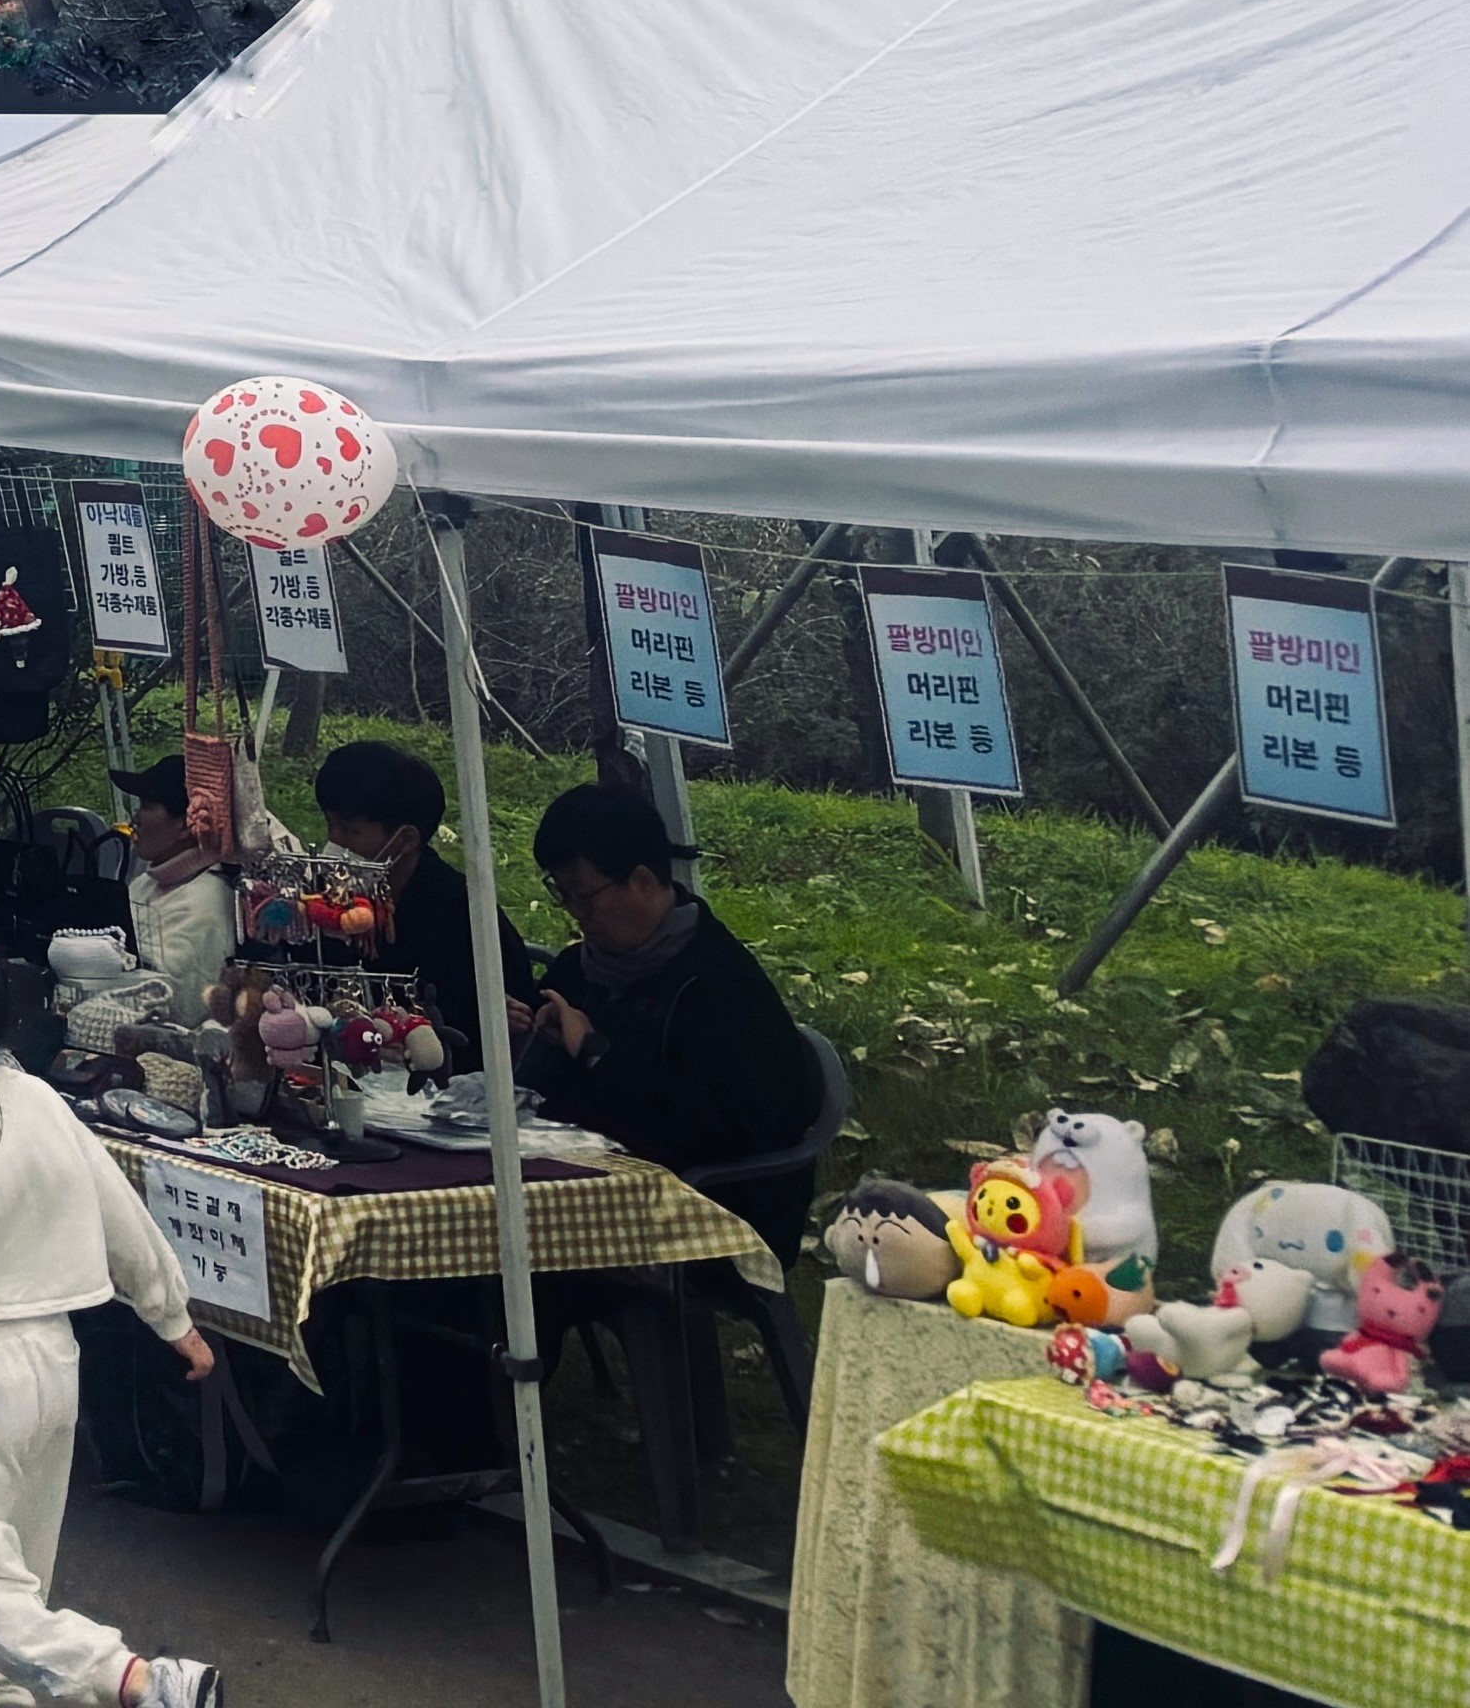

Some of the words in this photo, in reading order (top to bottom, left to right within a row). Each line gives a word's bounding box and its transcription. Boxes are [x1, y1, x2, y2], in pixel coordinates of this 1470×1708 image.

[615, 581, 700, 621] 팔방미인
[631, 628, 694, 663] 머리핀
[886, 623, 984, 659] 팔방미인
[1248, 630, 1363, 674] 팔방미인
[630, 670, 672, 703] 리본
[683, 680, 707, 709] 등
[906, 670, 981, 705] 머리핀
[1267, 684, 1352, 725] 머리핀
[908, 719, 957, 752] 리본
[970, 723, 994, 754] 등
[1263, 733, 1319, 773] 리본
[1334, 745, 1362, 779] 등
[191, 1253, 227, 1283] 가능
